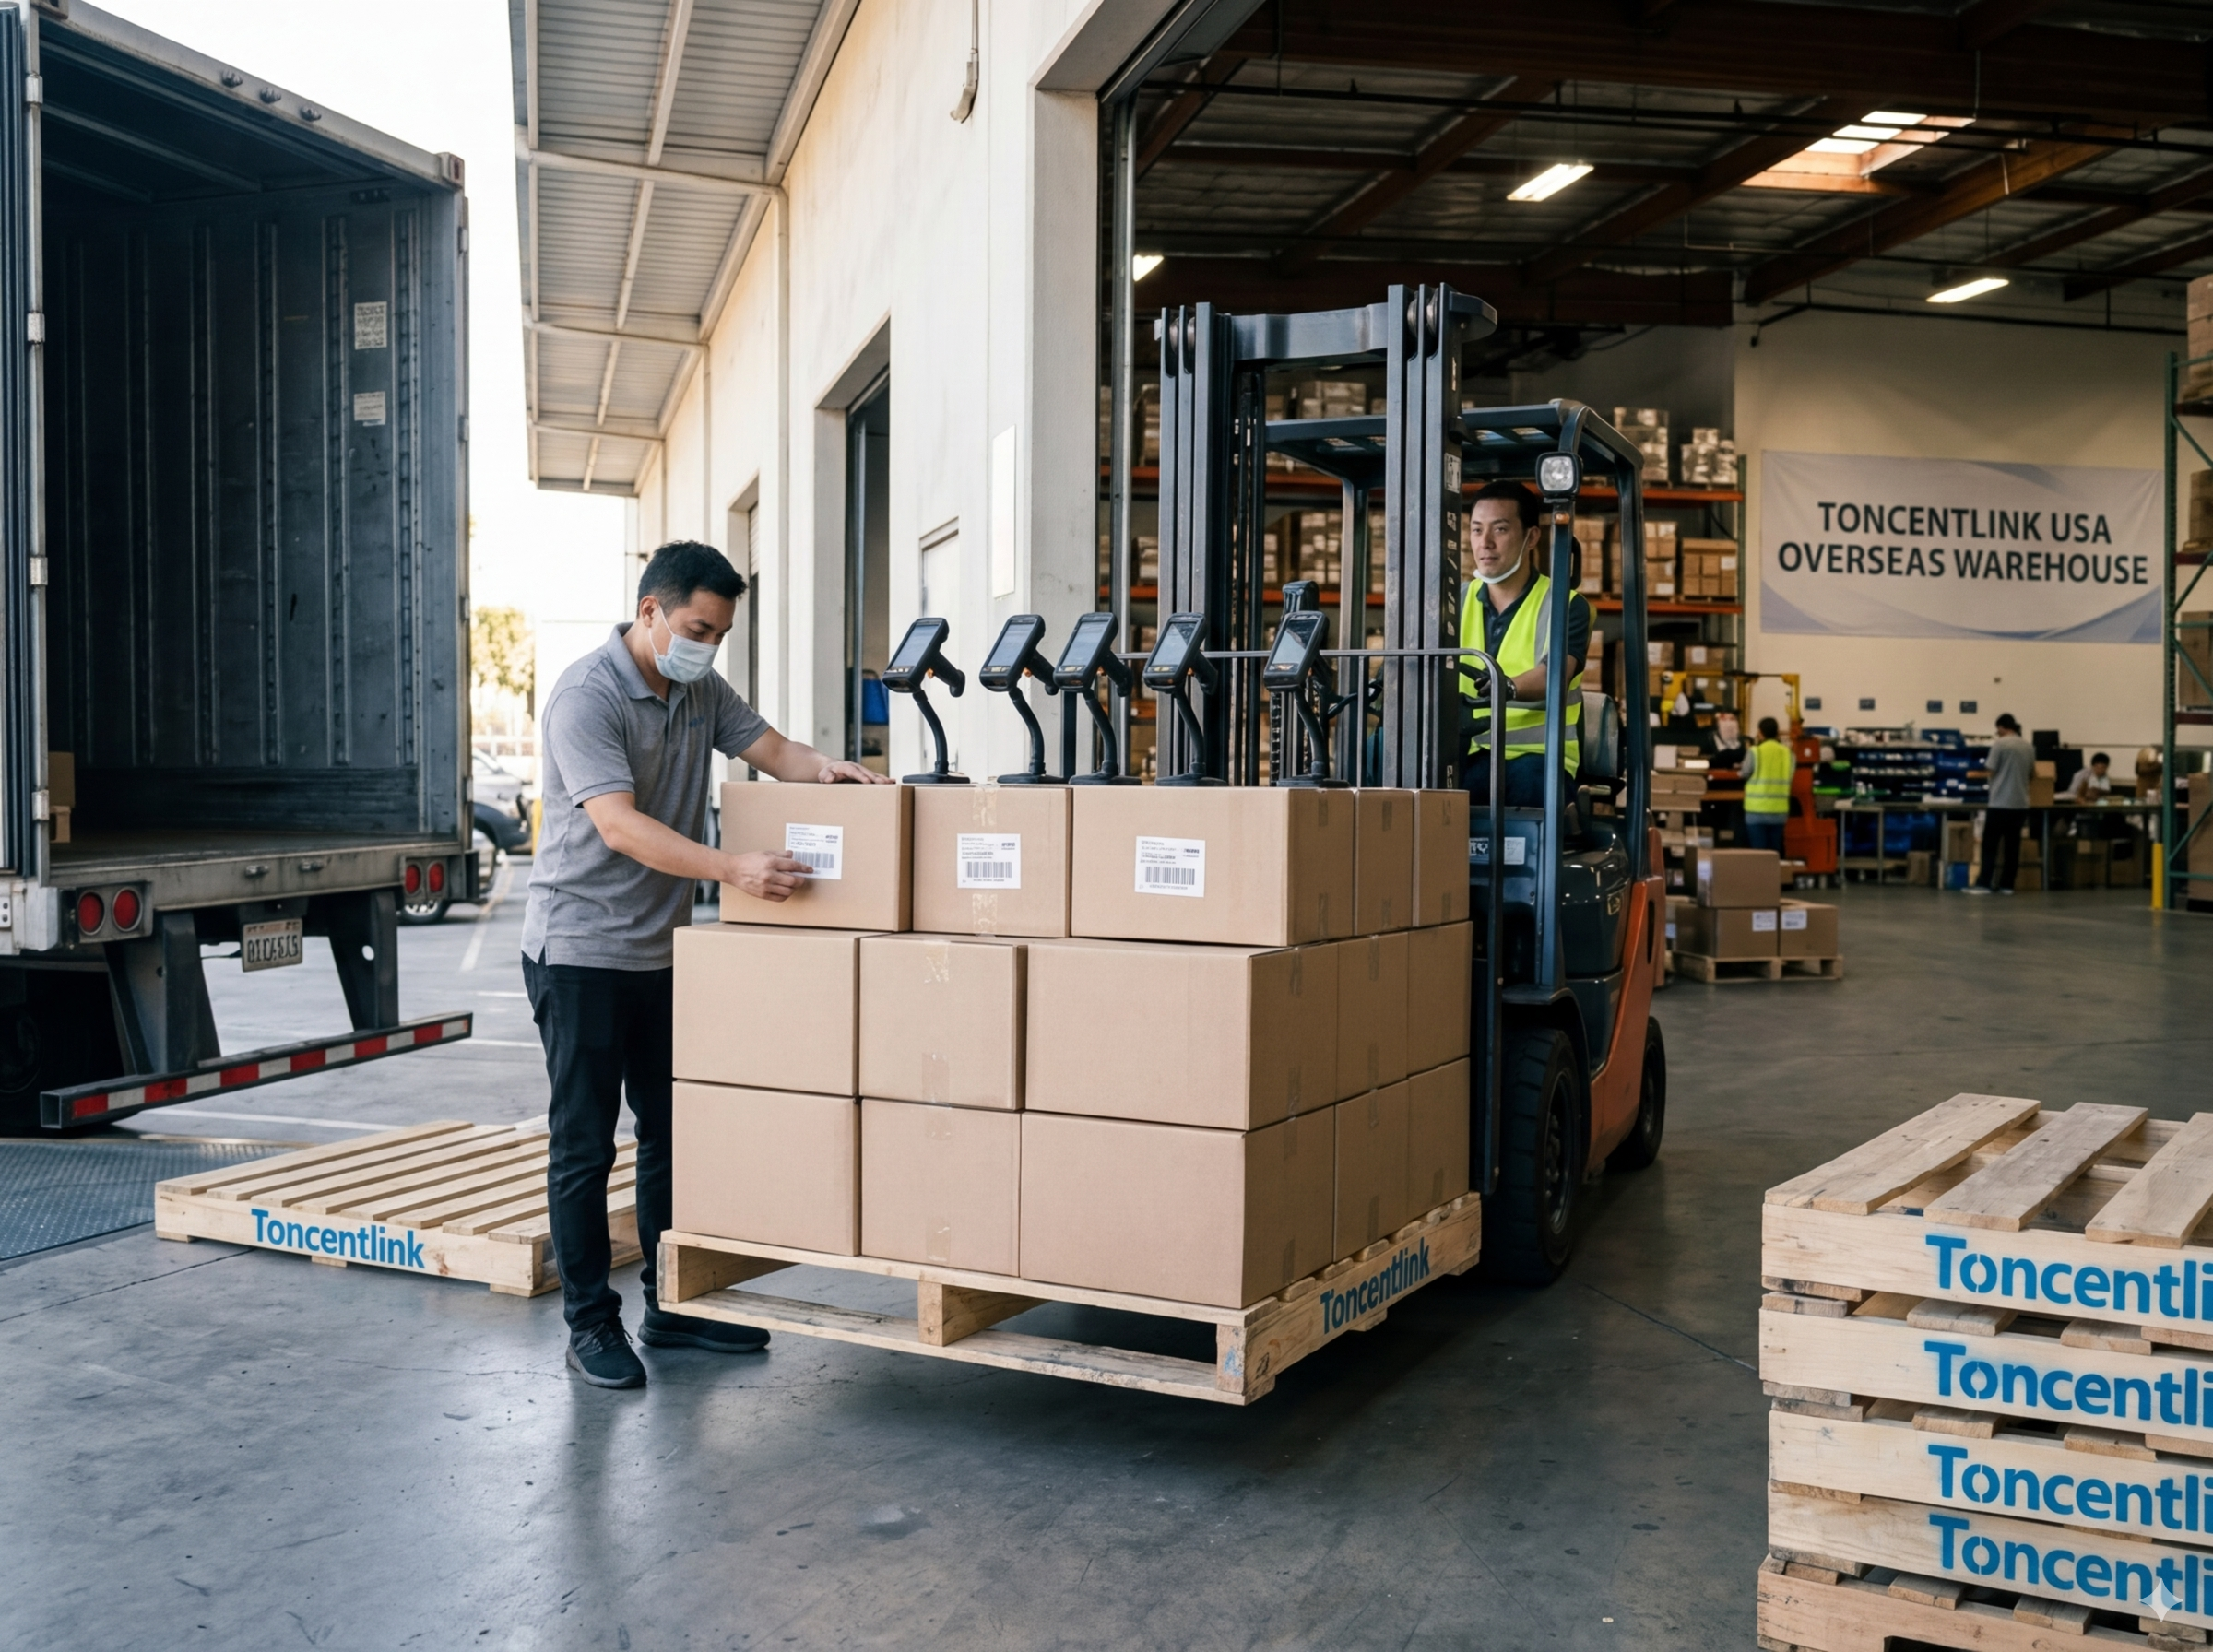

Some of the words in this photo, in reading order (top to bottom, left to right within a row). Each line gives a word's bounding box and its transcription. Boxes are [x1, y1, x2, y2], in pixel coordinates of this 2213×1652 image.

[1817, 502, 2042, 542] TONCENTLINK
[2051, 512, 2112, 545] USA
[1778, 542, 1946, 577] OVERSEAS
[1953, 549, 2148, 584] WAREHOUSE
[251, 1209, 425, 1268] Toncentlink
[1320, 1236, 1430, 1335] Toncentlink
